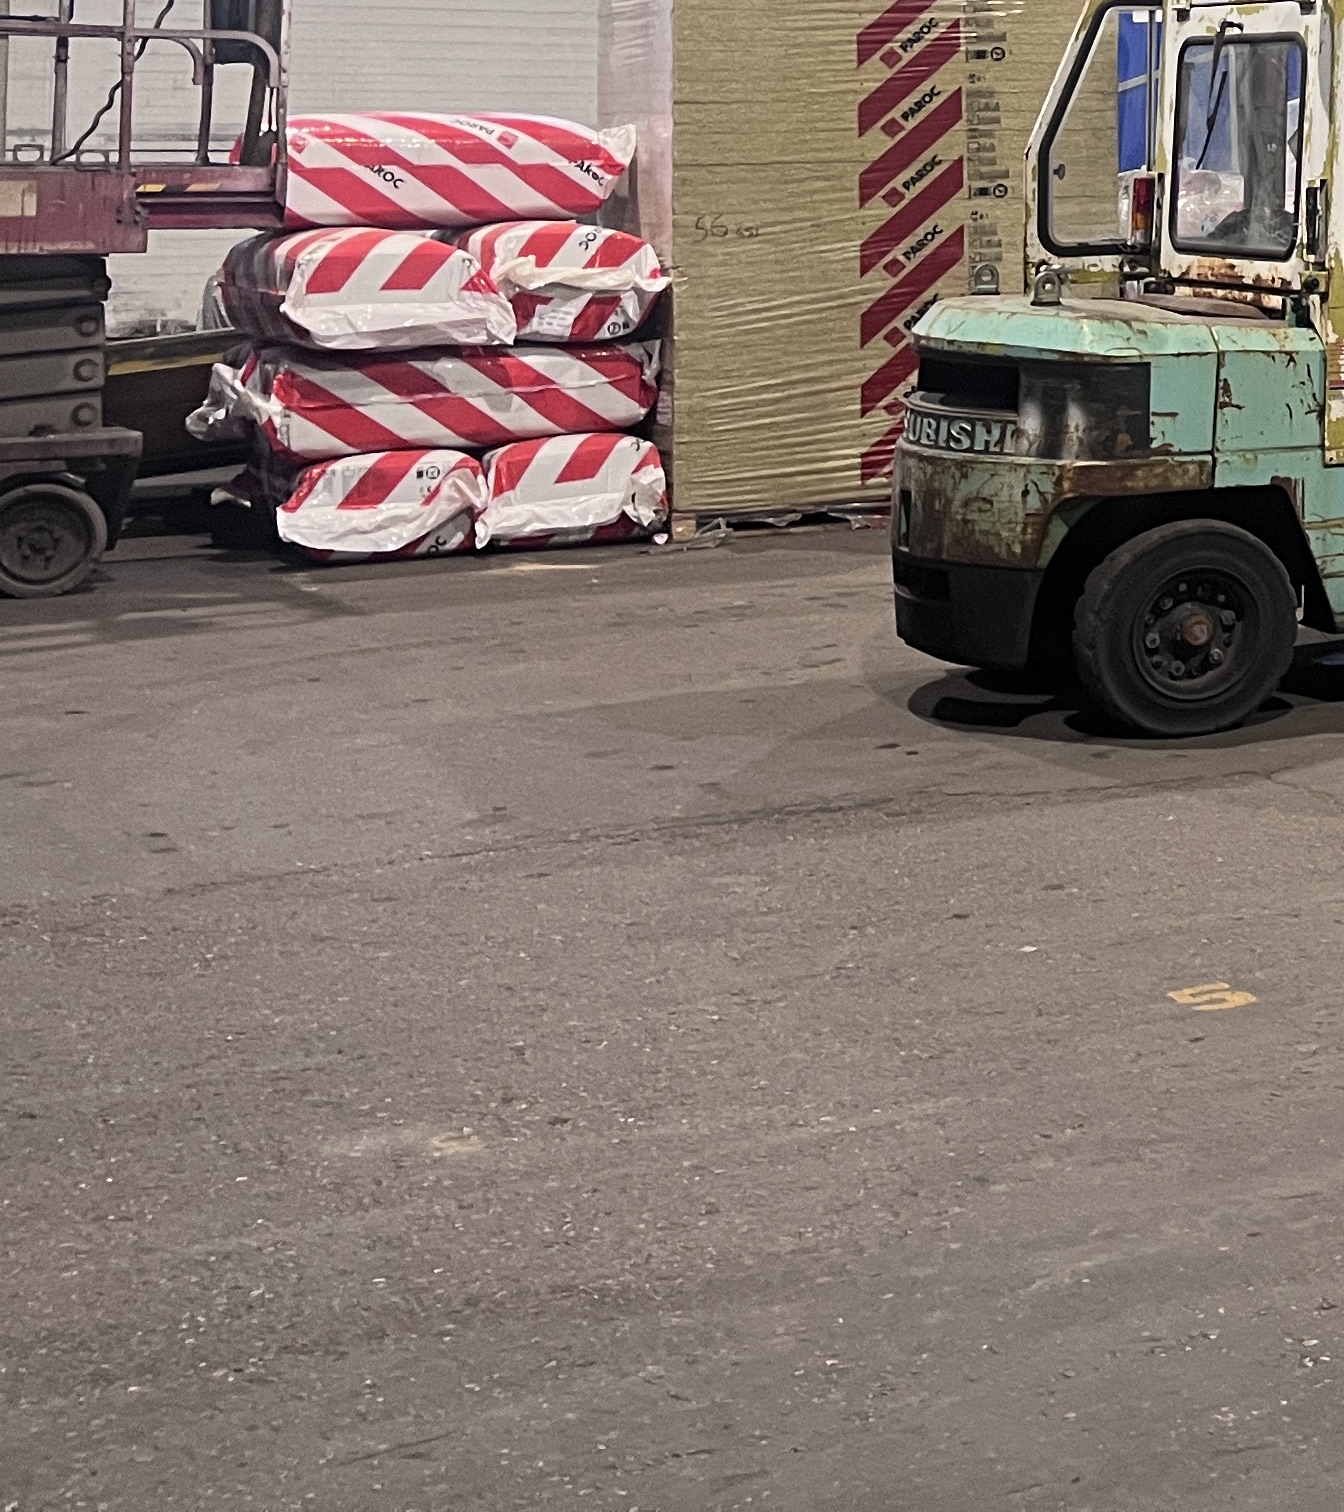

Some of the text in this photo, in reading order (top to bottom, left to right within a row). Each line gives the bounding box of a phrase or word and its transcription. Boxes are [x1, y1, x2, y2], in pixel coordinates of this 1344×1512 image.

[898, 17, 940, 53] PAROC
[900, 84, 942, 122] PAROC
[901, 154, 943, 191] PAROC
[901, 224, 944, 262] PAROC
[903, 408, 1017, 454] UBISHI
